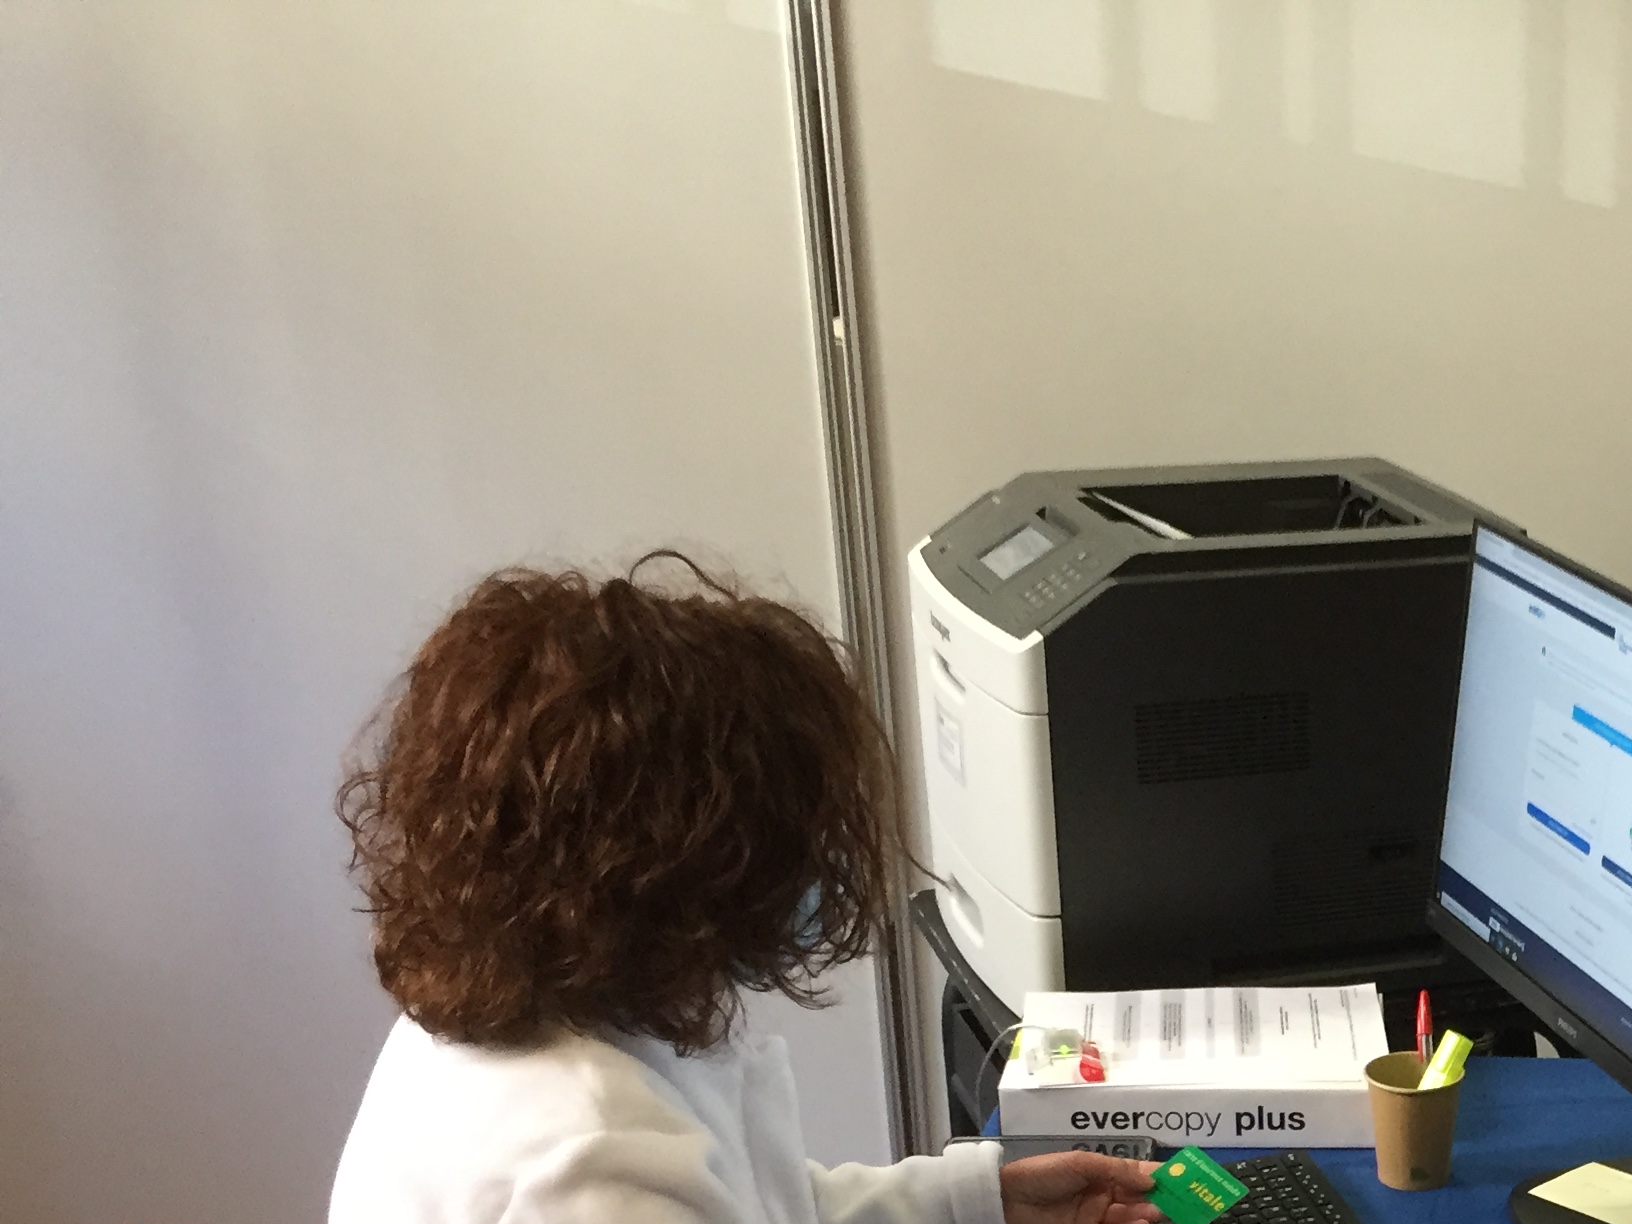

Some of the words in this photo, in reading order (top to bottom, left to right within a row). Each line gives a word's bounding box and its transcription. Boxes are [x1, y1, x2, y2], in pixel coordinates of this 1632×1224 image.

[1070, 1109, 1222, 1138] evercopy
[1235, 1105, 1306, 1137] plus
[1188, 1181, 1225, 1212] vitale
